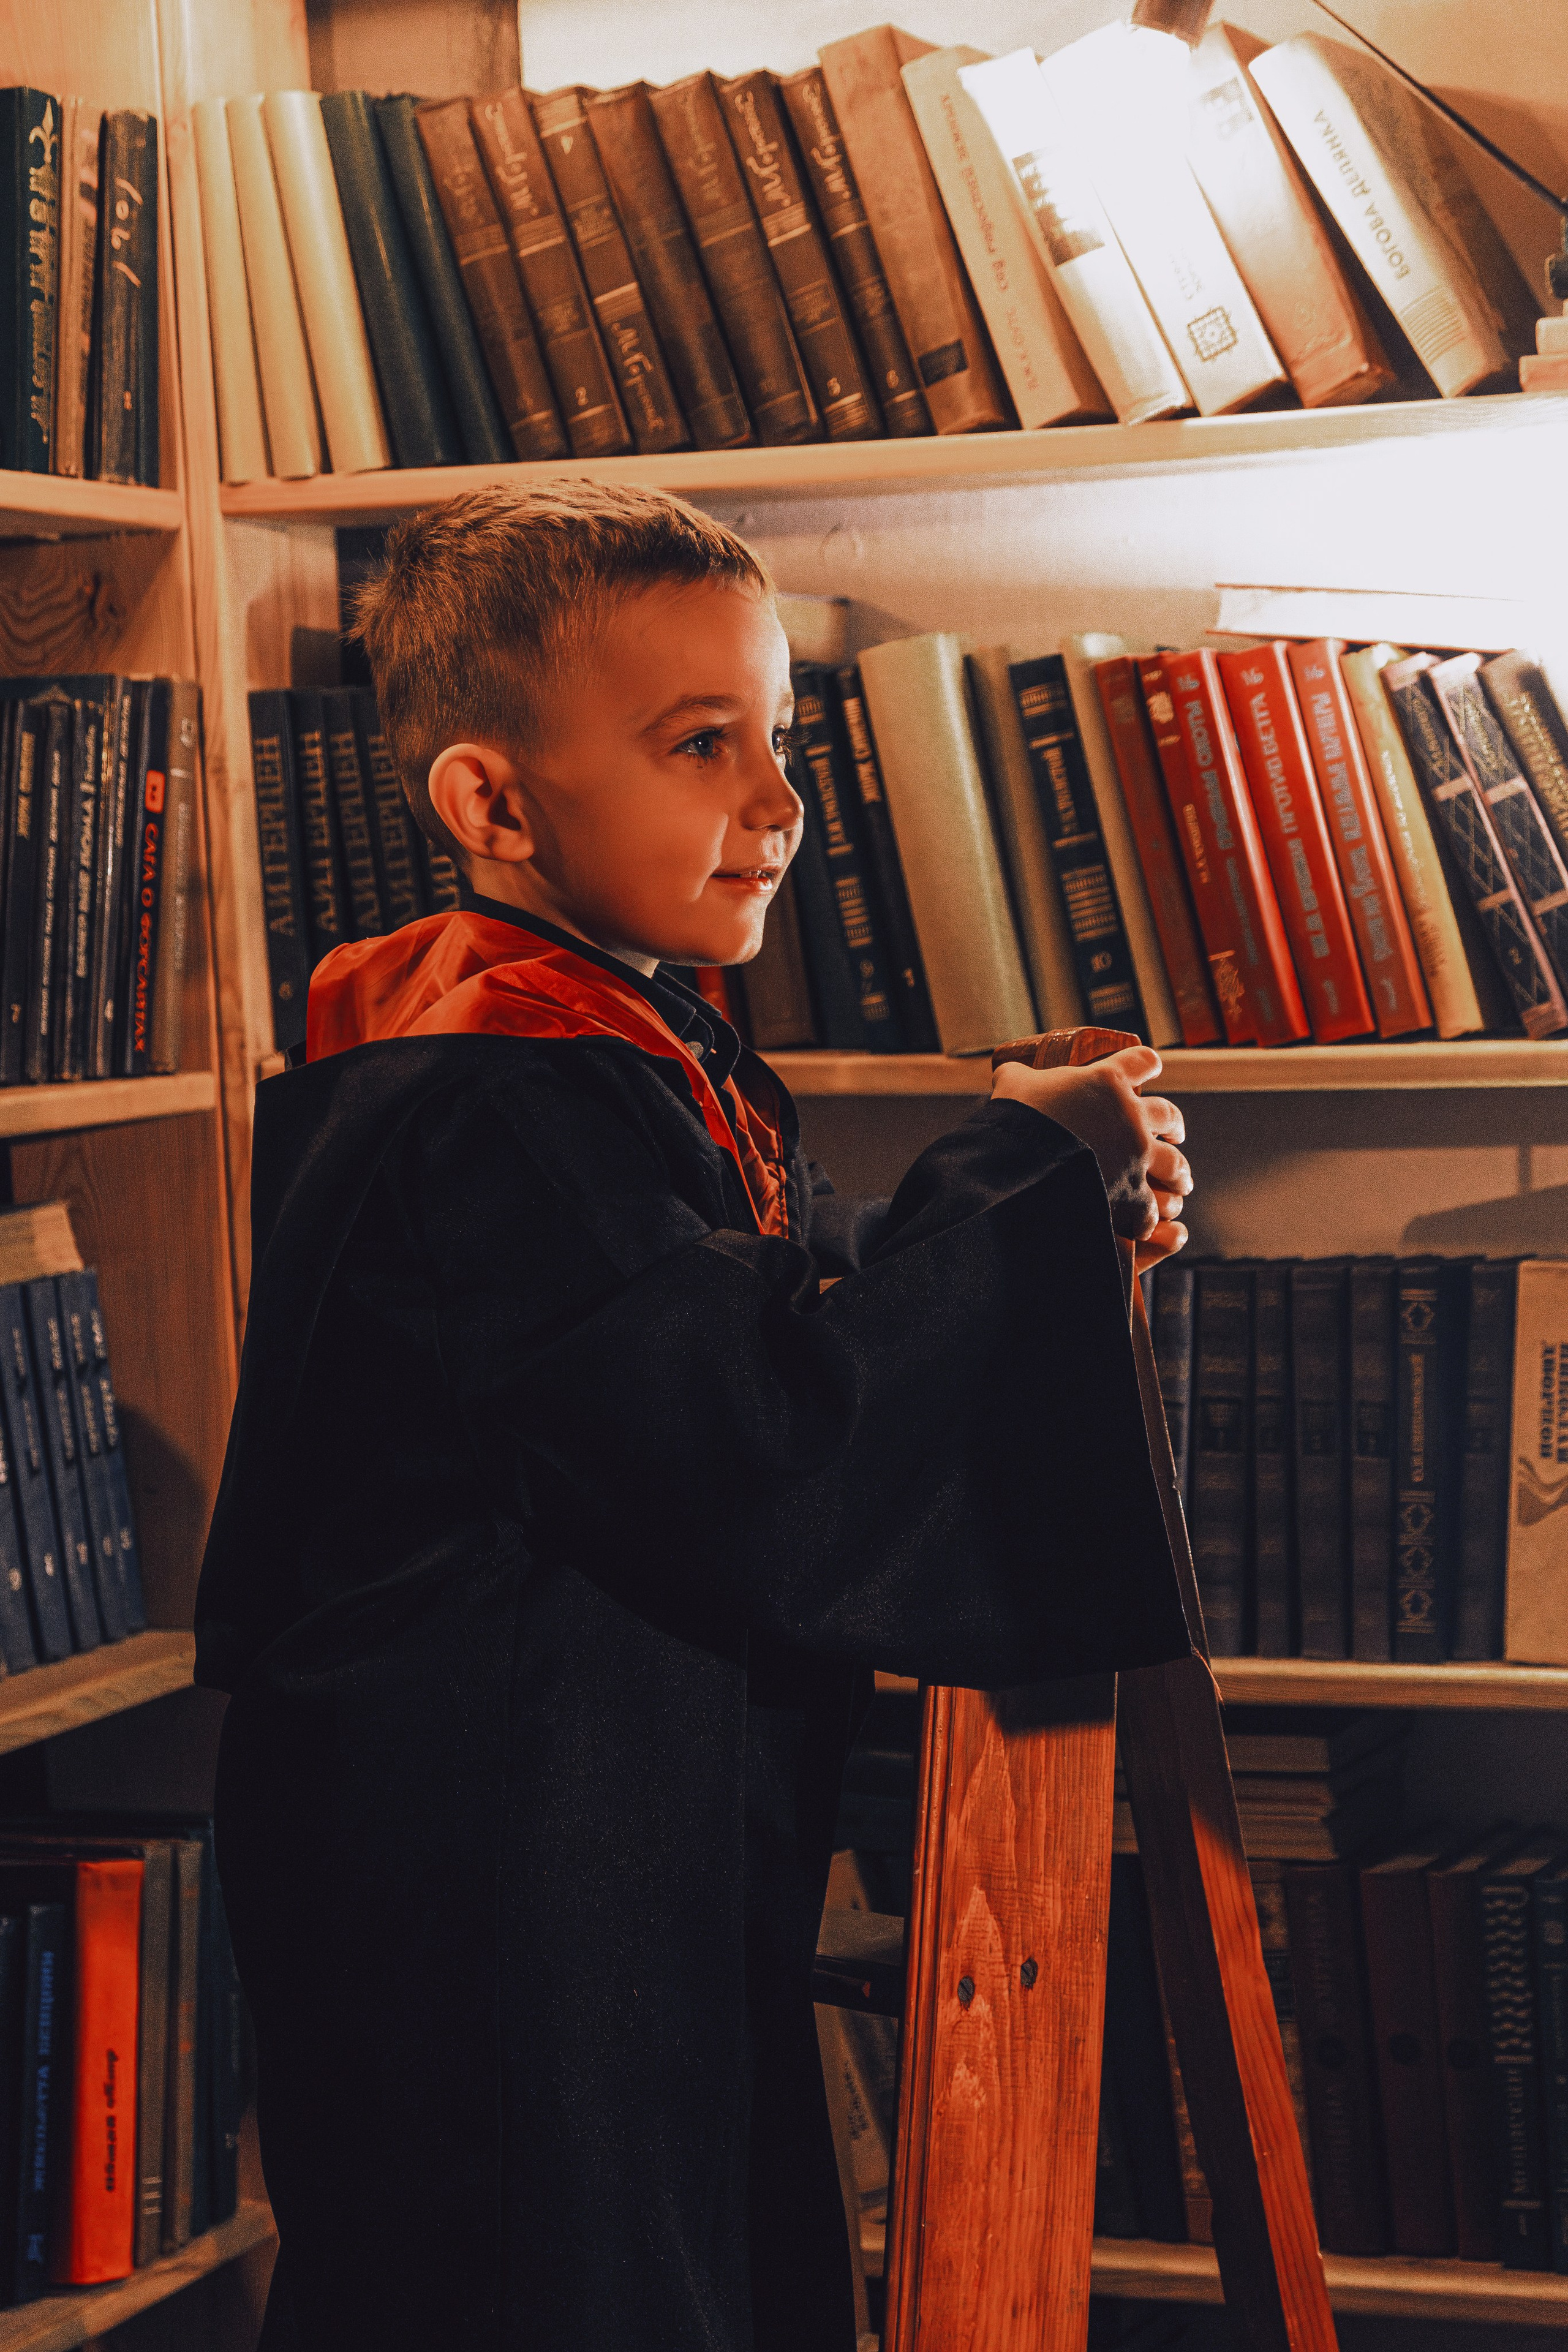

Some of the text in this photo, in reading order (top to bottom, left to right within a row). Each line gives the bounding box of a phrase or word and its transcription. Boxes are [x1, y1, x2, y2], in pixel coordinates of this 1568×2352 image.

[1314, 108, 1410, 280] БОГОВА ДЕЛЯНКА
[1247, 691, 1298, 834] ПРОТИВ ВЕТРА
[141, 822, 159, 883] САГА
[141, 886, 156, 909] О
